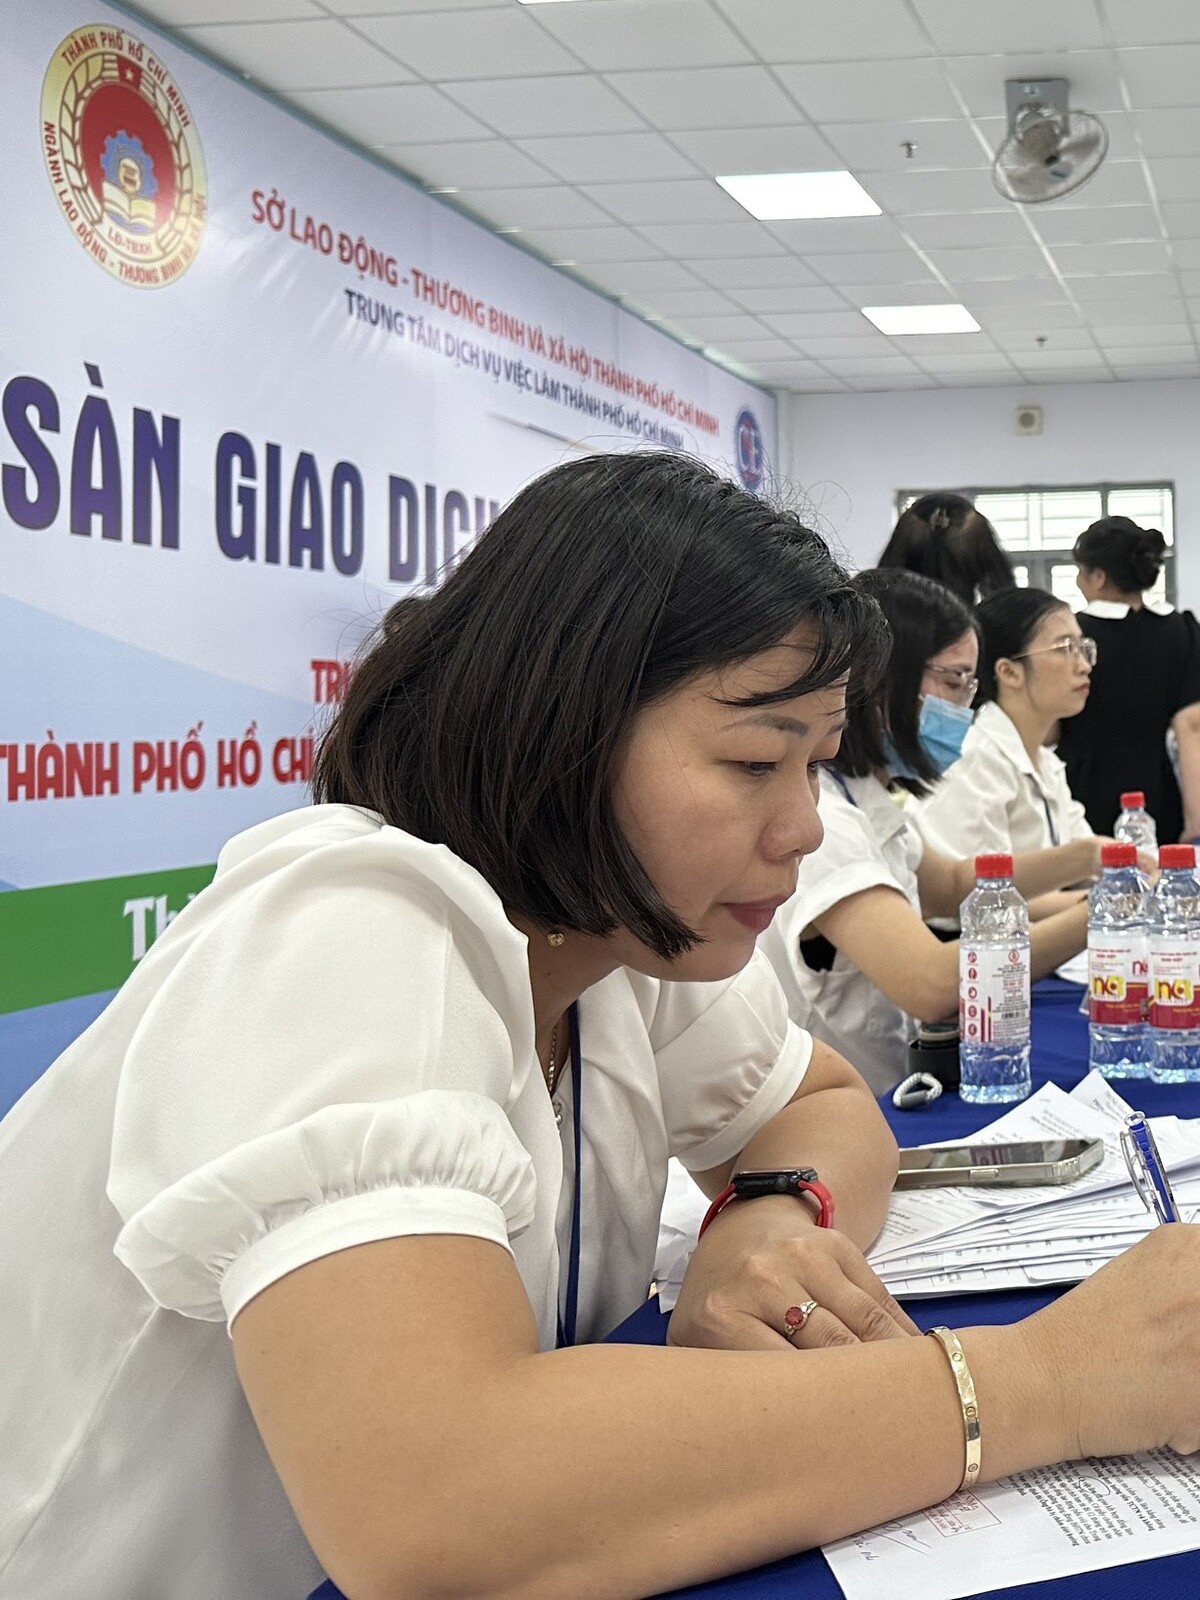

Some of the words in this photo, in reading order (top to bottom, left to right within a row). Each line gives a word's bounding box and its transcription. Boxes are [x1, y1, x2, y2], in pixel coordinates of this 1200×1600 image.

[61, 31, 98, 67] THÀNH
[101, 29, 125, 51] PHỐ
[128, 41, 146, 62] HỒ
[165, 85, 191, 128] MINH
[43, 120, 64, 184] NGÀNH
[58, 190, 78, 221] LAO
[76, 222, 108, 264] ĐỘNG
[251, 187, 286, 232] SỞ
[289, 206, 334, 256] LAO
[337, 231, 399, 288] ĐỘNG
[410, 266, 486, 328] THƯƠNG
[488, 307, 525, 346] BINH
[527, 325, 547, 355] VÀ
[569, 346, 593, 382] HỘI
[592, 358, 636, 396] THÀNH
[636, 379, 660, 409] PHỐ
[661, 391, 678, 417] HỒ
[678, 398, 695, 425] CHÍ
[695, 408, 720, 436] MINH
[344, 287, 404, 336] TRUNG
[407, 315, 442, 352] TÂM
[444, 331, 480, 369] DỊCH
[481, 348, 502, 384] VỤ
[503, 354, 533, 394] VIỆC
[534, 370, 562, 403] LÀM
[562, 384, 602, 419] THÀNH
[602, 404, 626, 430] PHỐ
[625, 411, 643, 436] HỒ
[642, 418, 660, 441] CHÍ
[1, 361, 182, 550] SÀN
[215, 430, 365, 579] GIAO
[132, 721, 206, 794] PHỐ
[216, 721, 262, 788] HỒ
